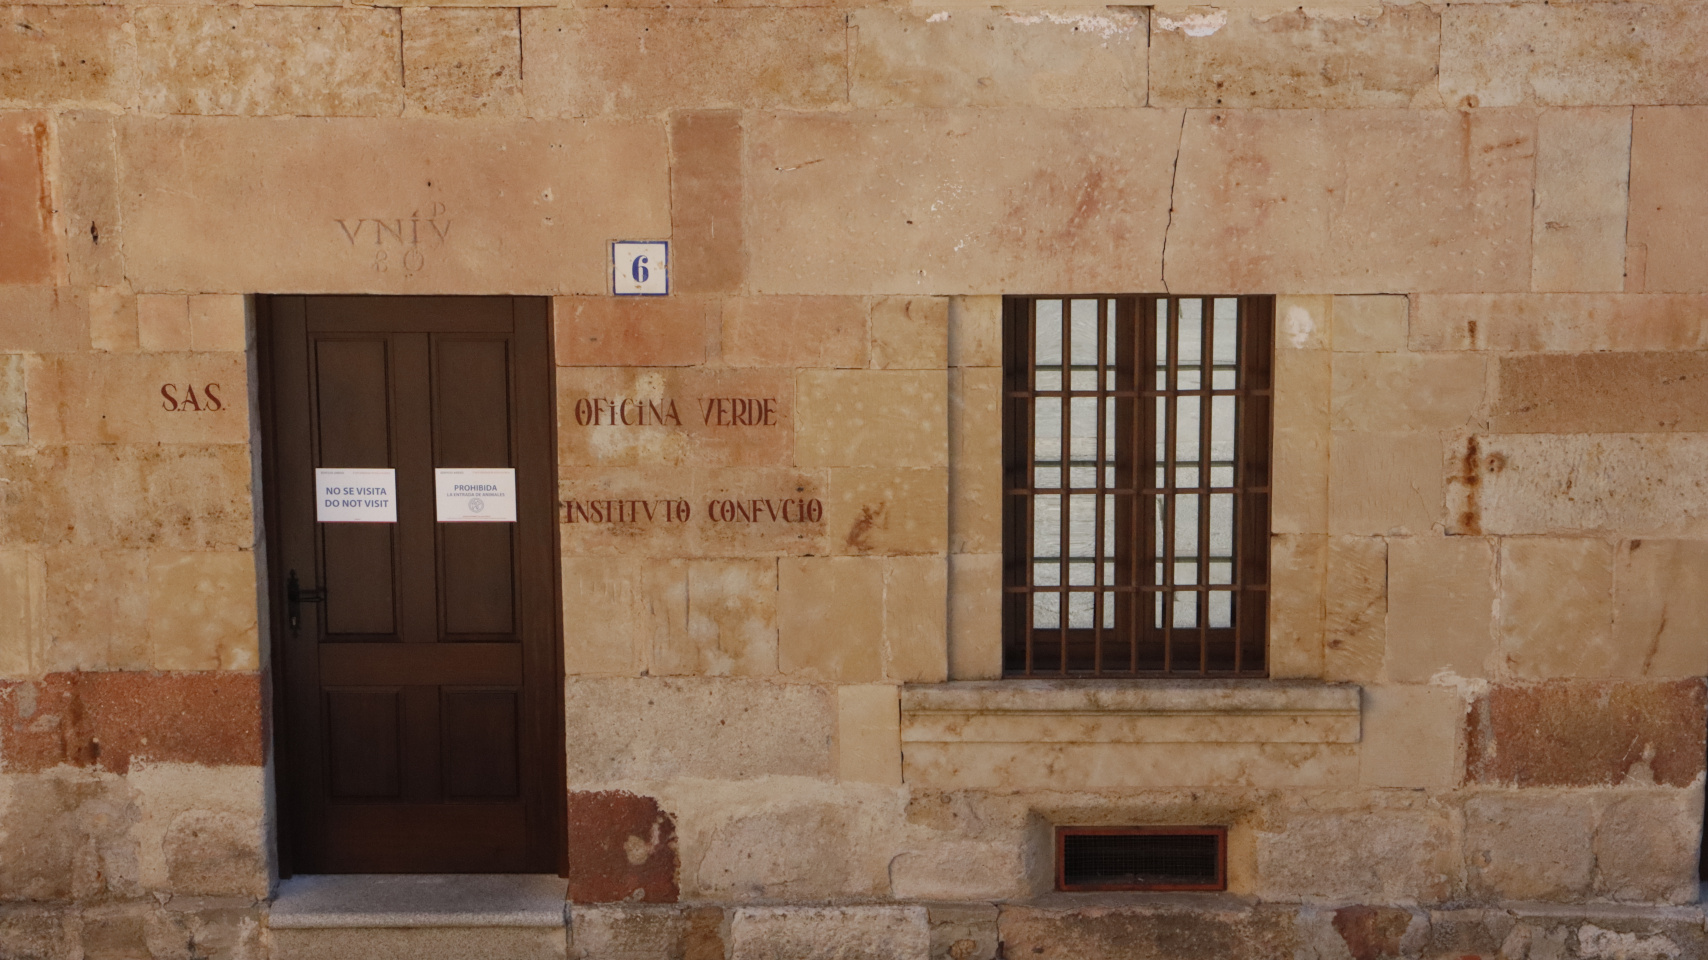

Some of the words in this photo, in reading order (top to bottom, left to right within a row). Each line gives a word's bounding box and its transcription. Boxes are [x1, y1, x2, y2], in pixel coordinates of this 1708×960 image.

[632, 254, 649, 283] 6
[160, 382, 226, 412] S.A.S.
[698, 397, 777, 427] VERDE
[326, 487, 341, 496] NO
[343, 487, 355, 496] SE
[356, 487, 387, 496] VISITA
[454, 484, 498, 492] PROHIBIDA
[325, 499, 340, 508] DO
[342, 499, 363, 508] NOT
[364, 499, 389, 508] VISIT
